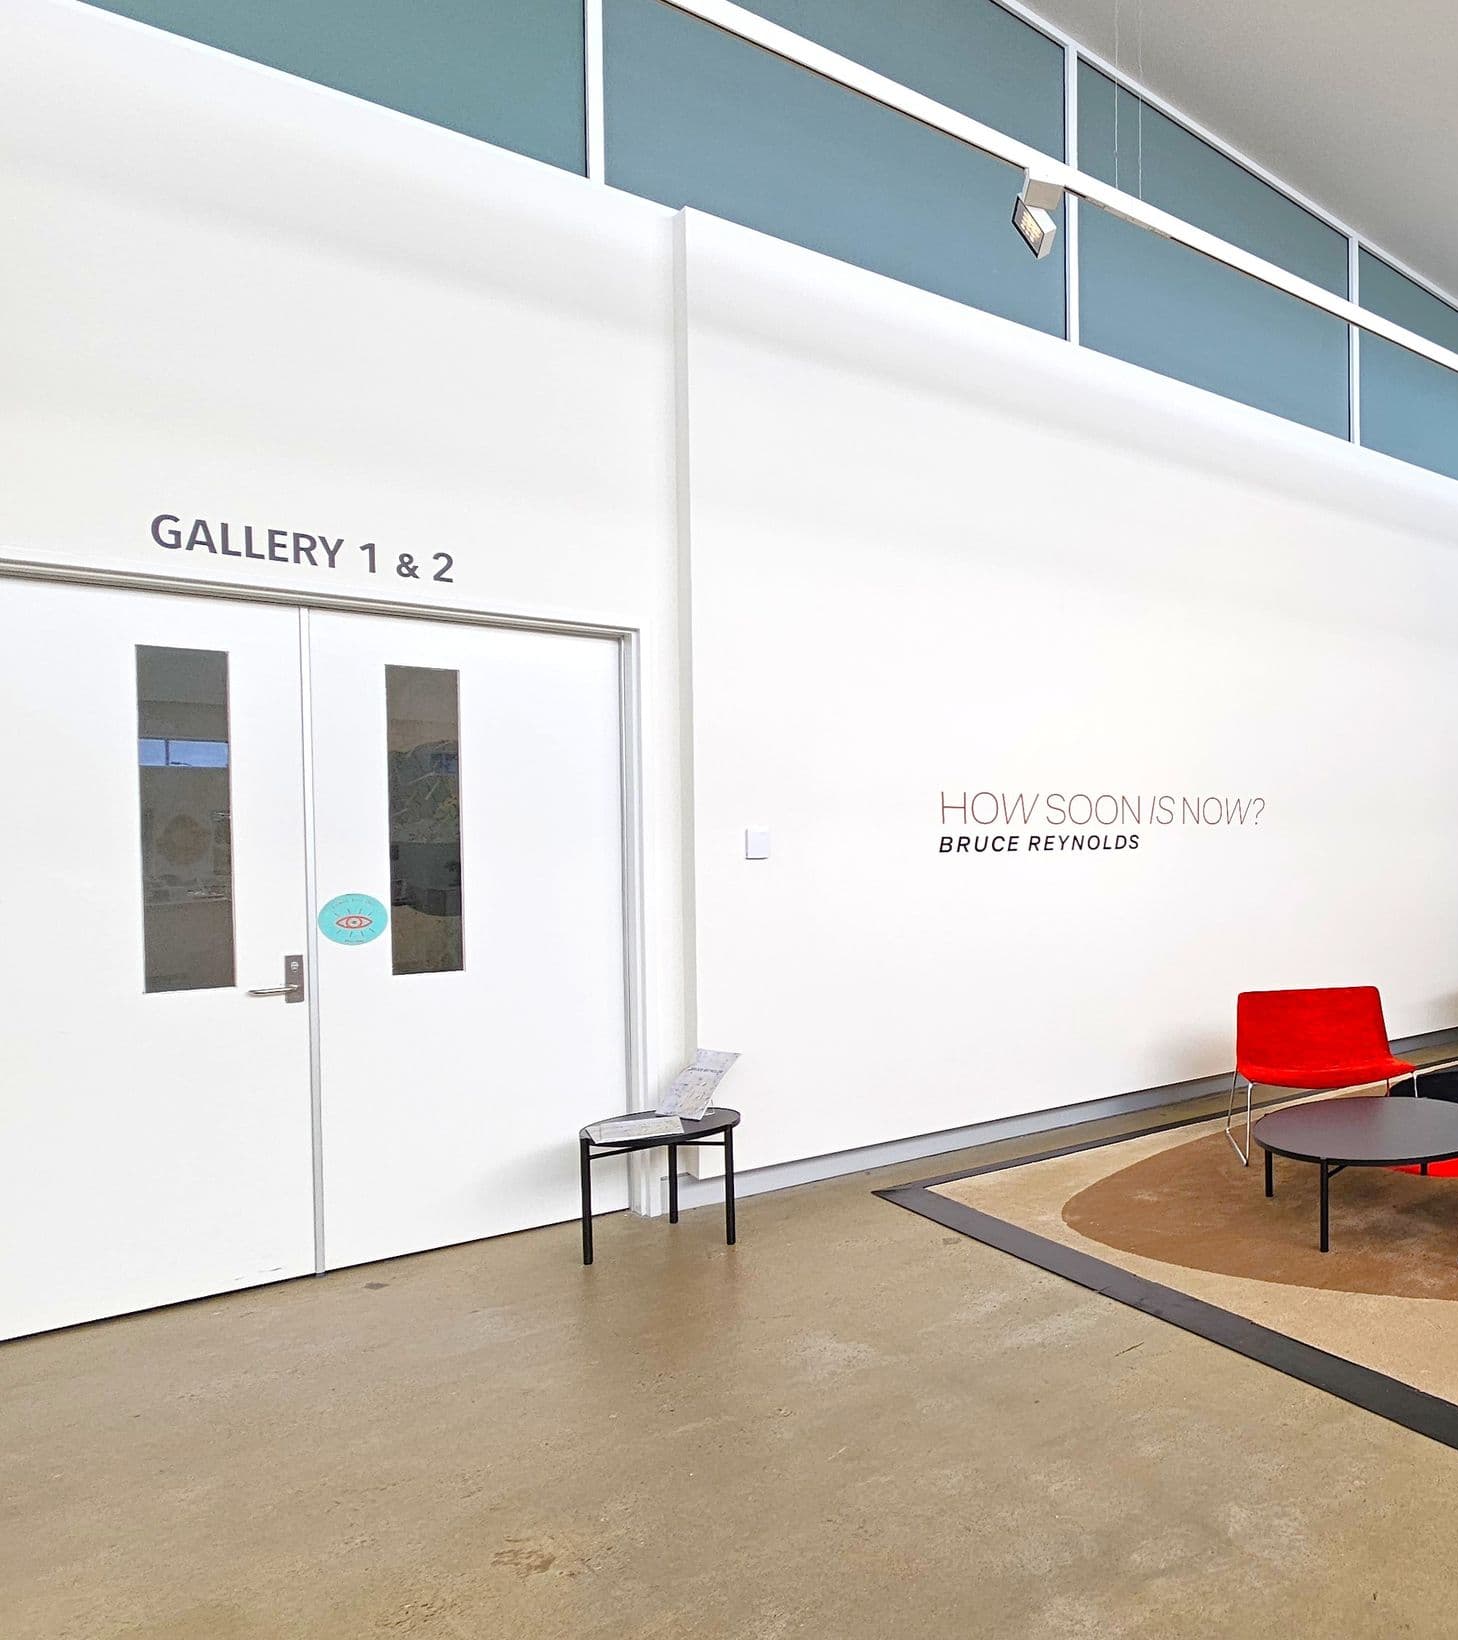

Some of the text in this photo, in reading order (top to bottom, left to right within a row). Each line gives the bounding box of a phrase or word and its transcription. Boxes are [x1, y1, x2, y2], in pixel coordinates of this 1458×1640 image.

[150, 513, 455, 584] GALLERY 1 & 2
[940, 790, 1266, 826] HOW SOON IS NOW?
[938, 834, 1141, 854] BRUCE REYNOLDS
